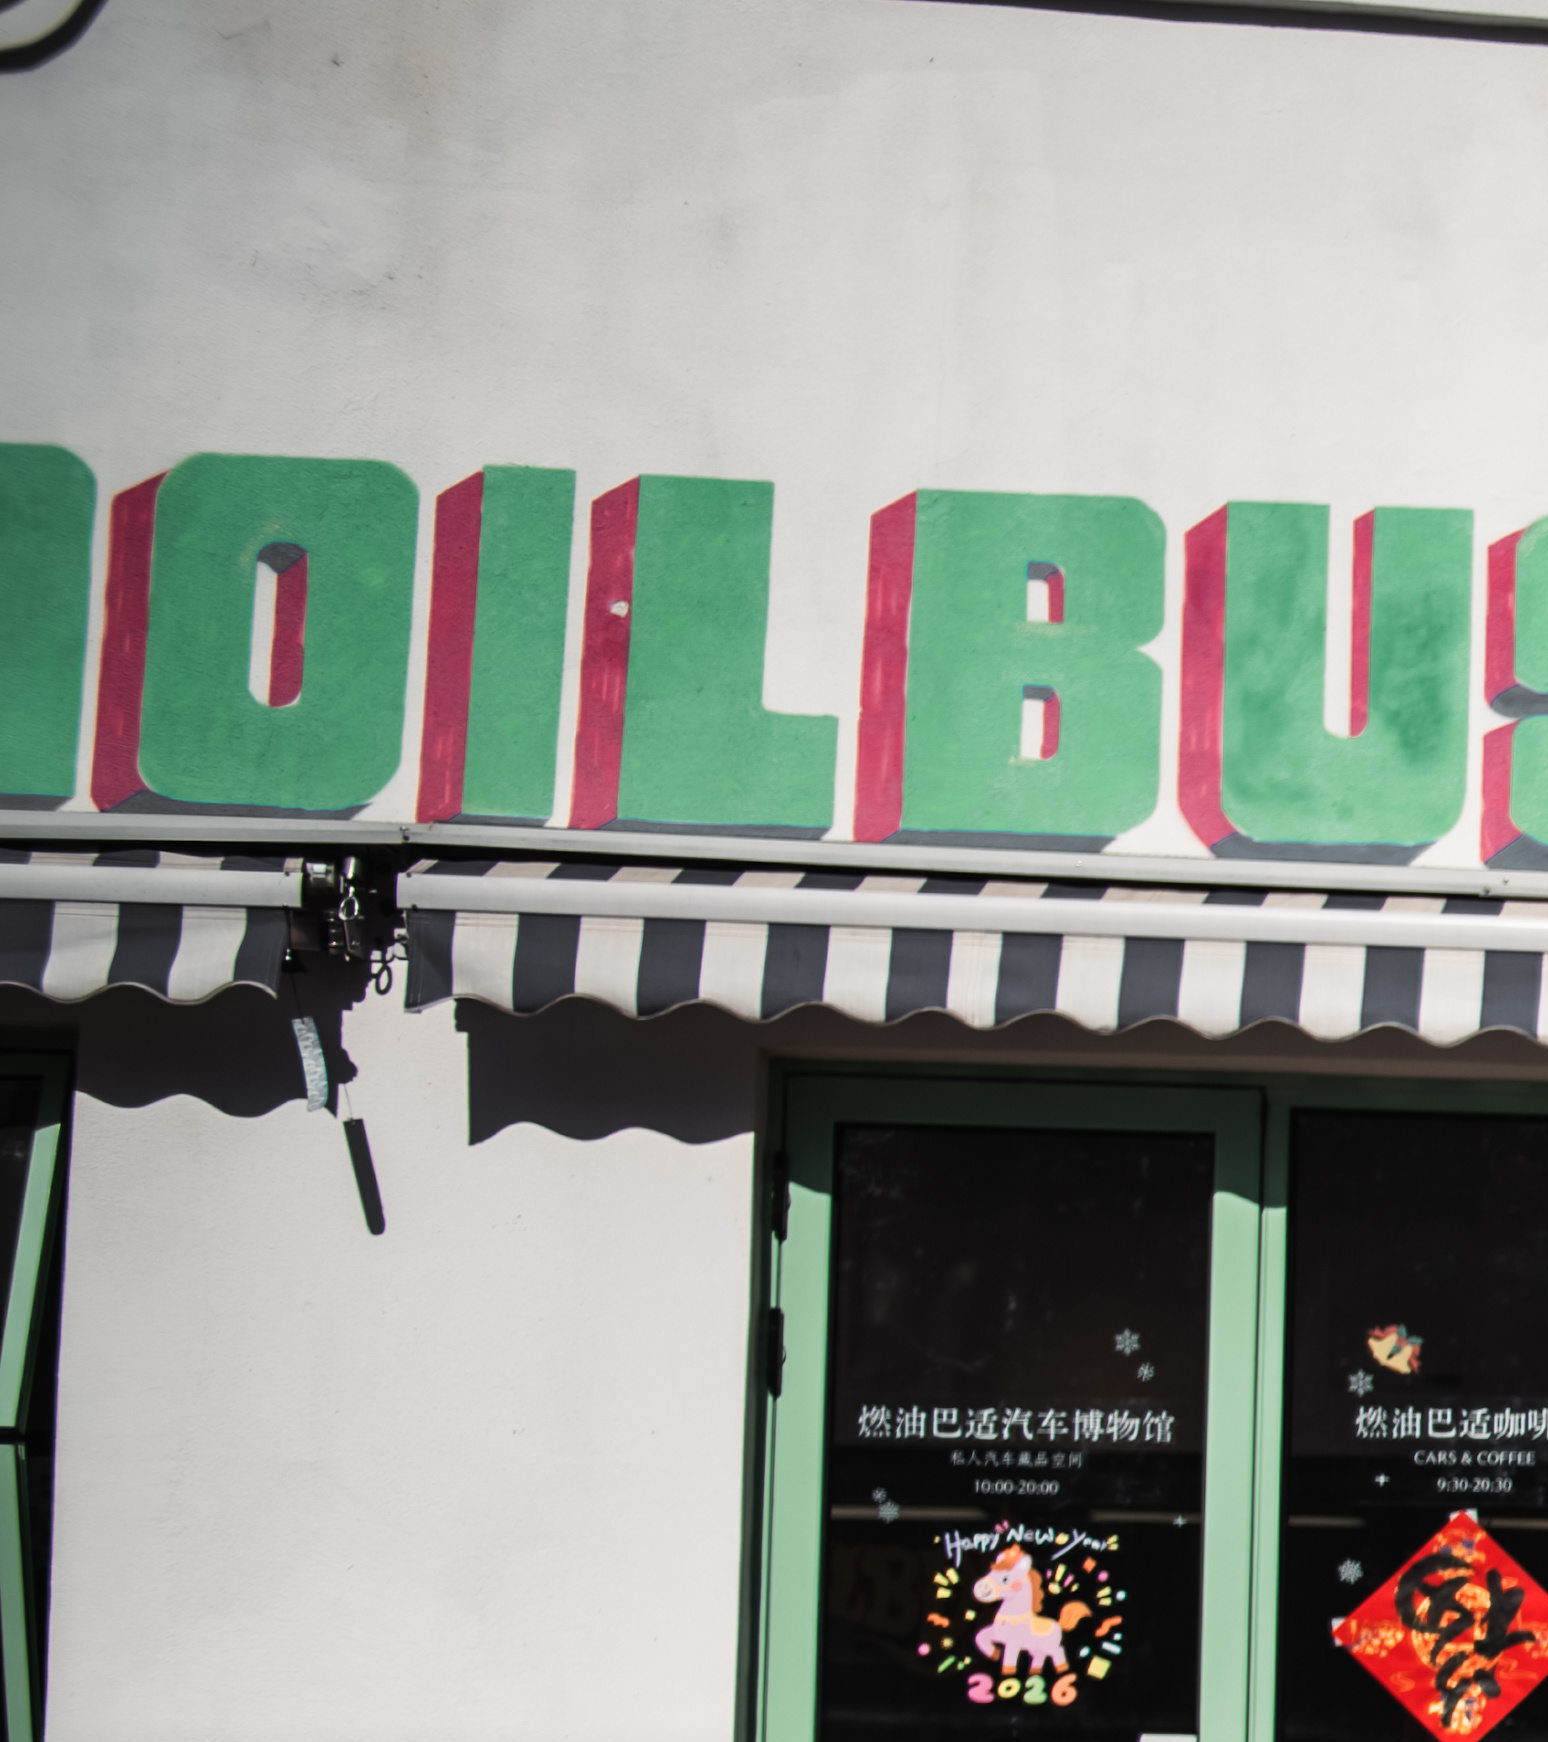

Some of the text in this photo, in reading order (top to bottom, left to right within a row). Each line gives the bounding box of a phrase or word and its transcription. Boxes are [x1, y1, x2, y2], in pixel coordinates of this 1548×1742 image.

[858, 1404, 1175, 1444] 燃油巴适汽车博物馆
[950, 1449, 1083, 1469] 私人汽车藏品空间
[1413, 1449, 1537, 1467] CARS & COFFEE
[974, 1479, 1060, 1495] 10:00-20:00
[1437, 1476, 1514, 1493] 9:30-20:30
[944, 1529, 999, 1568] Happy
[967, 1672, 1078, 1706] 2026
